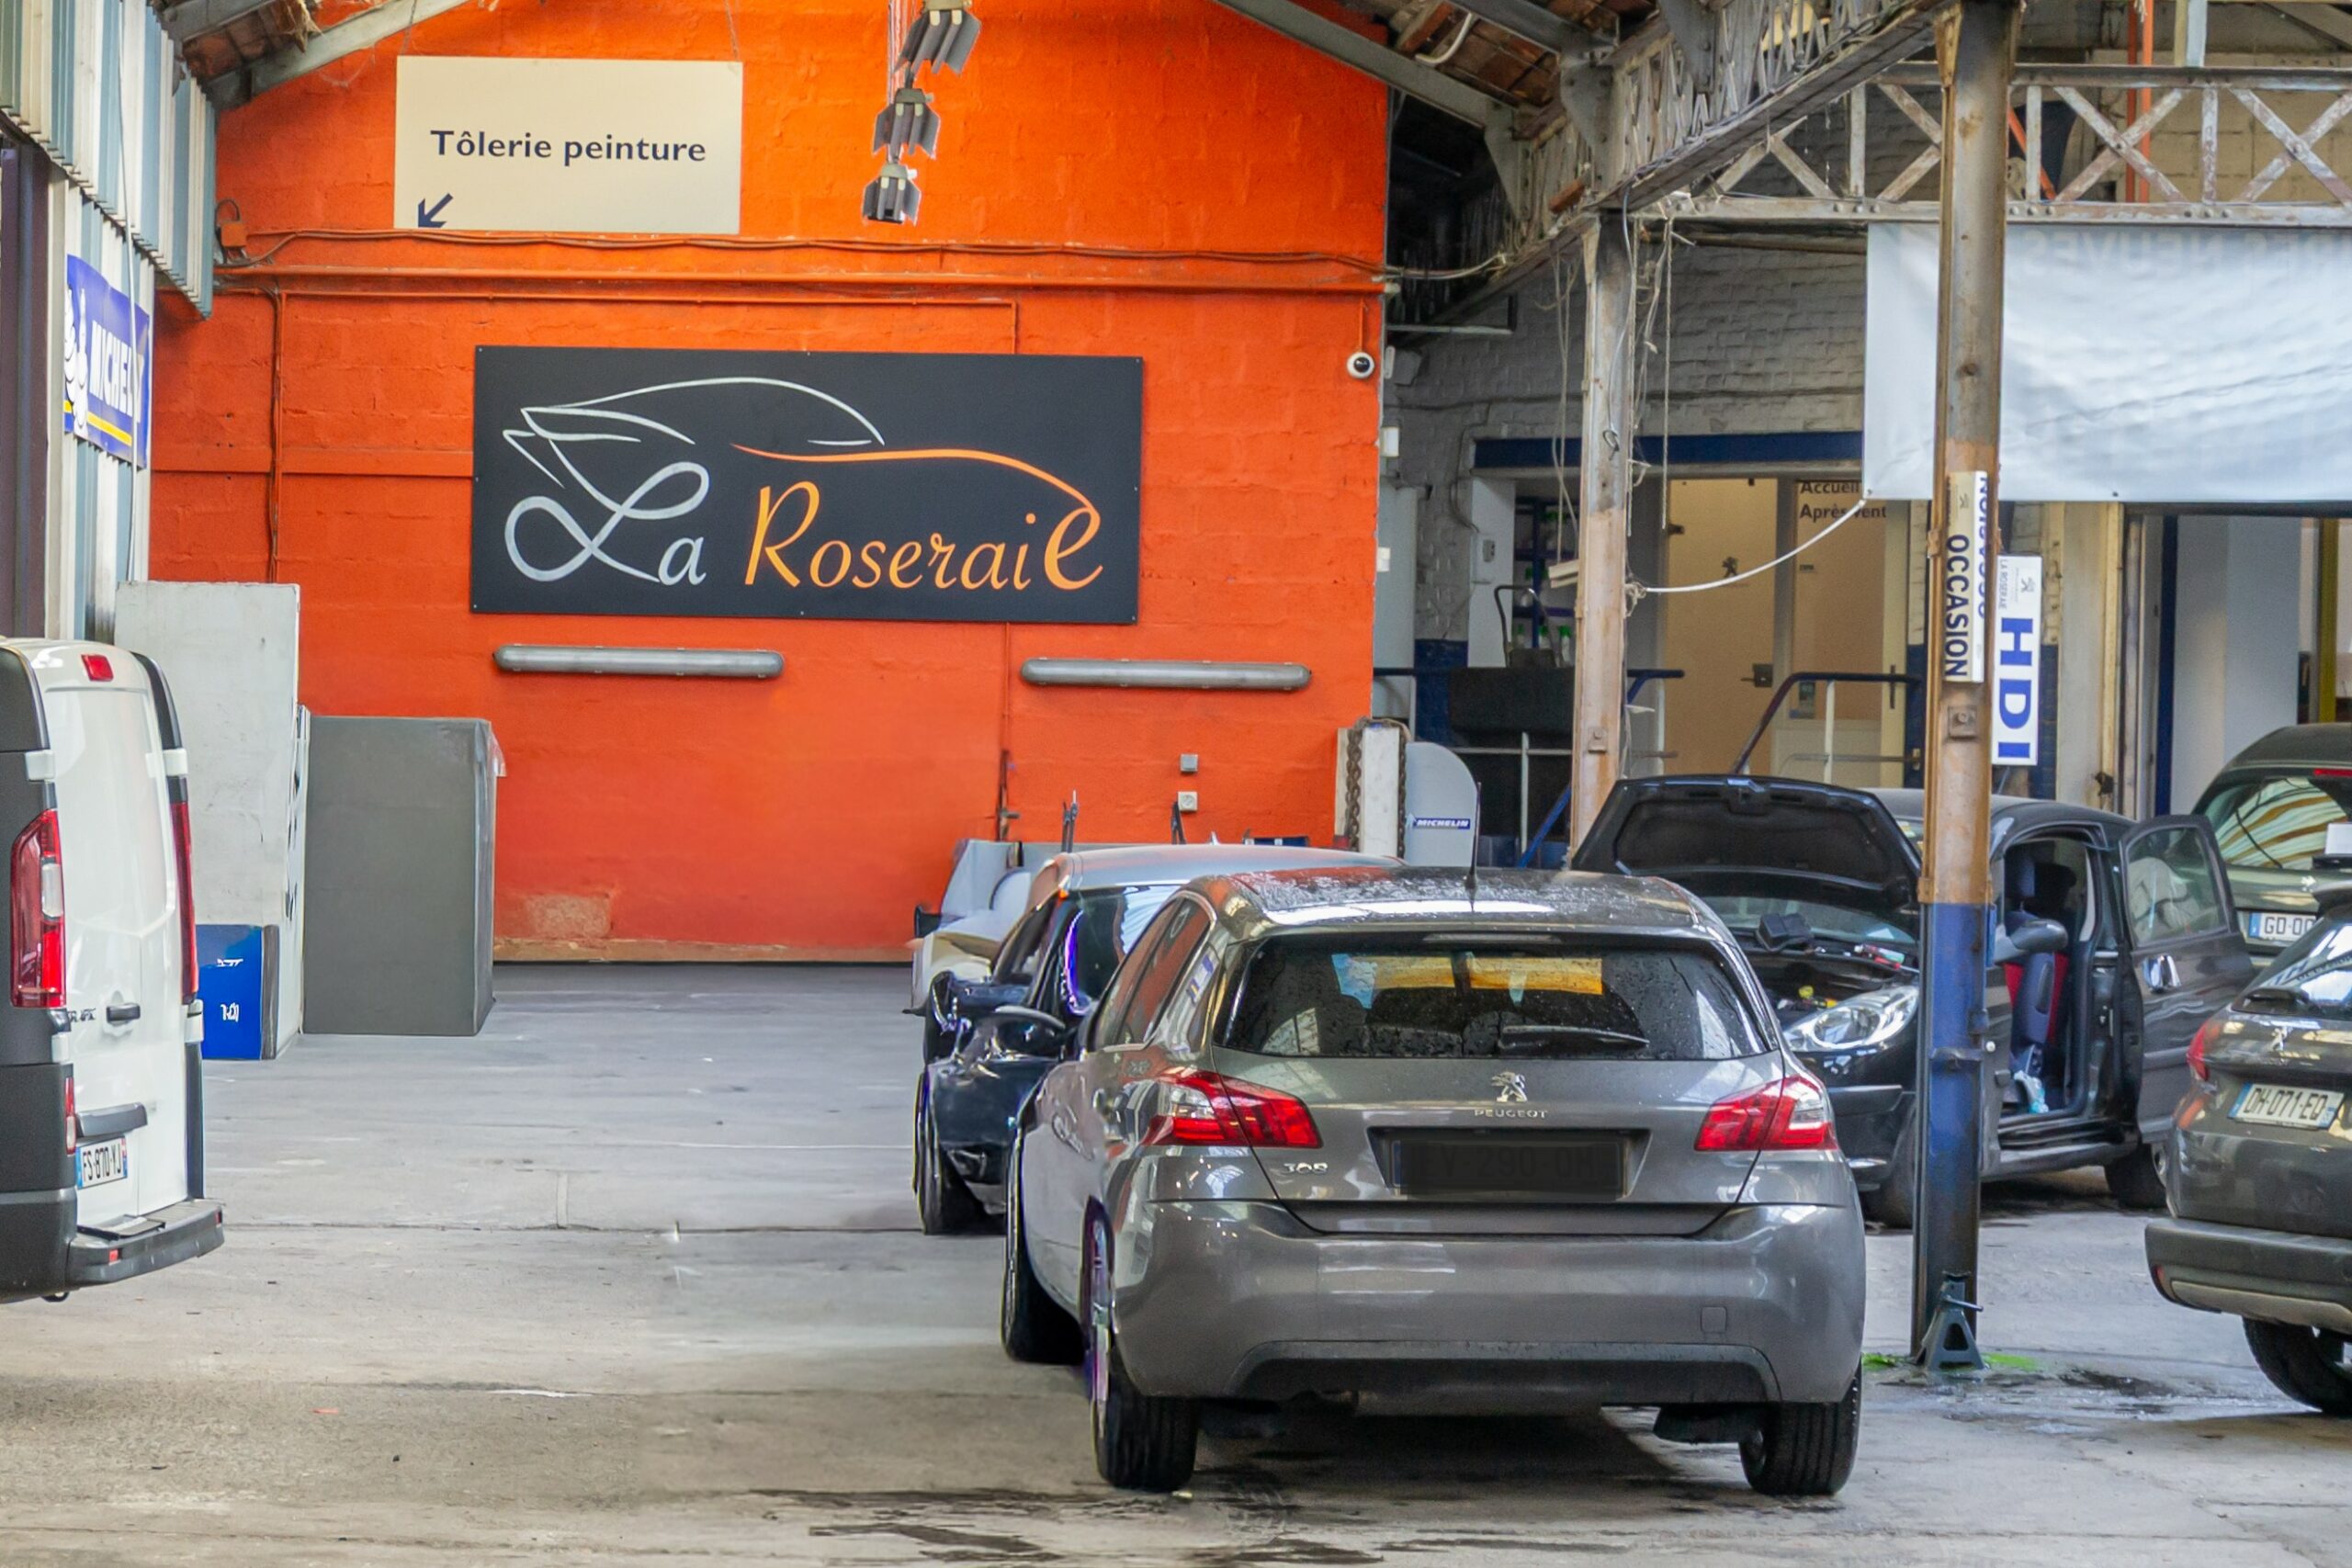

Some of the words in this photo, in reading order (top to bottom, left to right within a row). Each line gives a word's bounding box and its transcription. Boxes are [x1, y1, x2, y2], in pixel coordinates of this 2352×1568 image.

[430, 130, 551, 158] Tôlerie
[564, 134, 707, 166] peinture
[504, 442, 708, 587] La
[744, 480, 1103, 591] Roseraie
[1945, 534, 1970, 676] OCCASION
[1997, 617, 2033, 758] HDI
[1474, 1109, 1548, 1119] PEUGEOT
